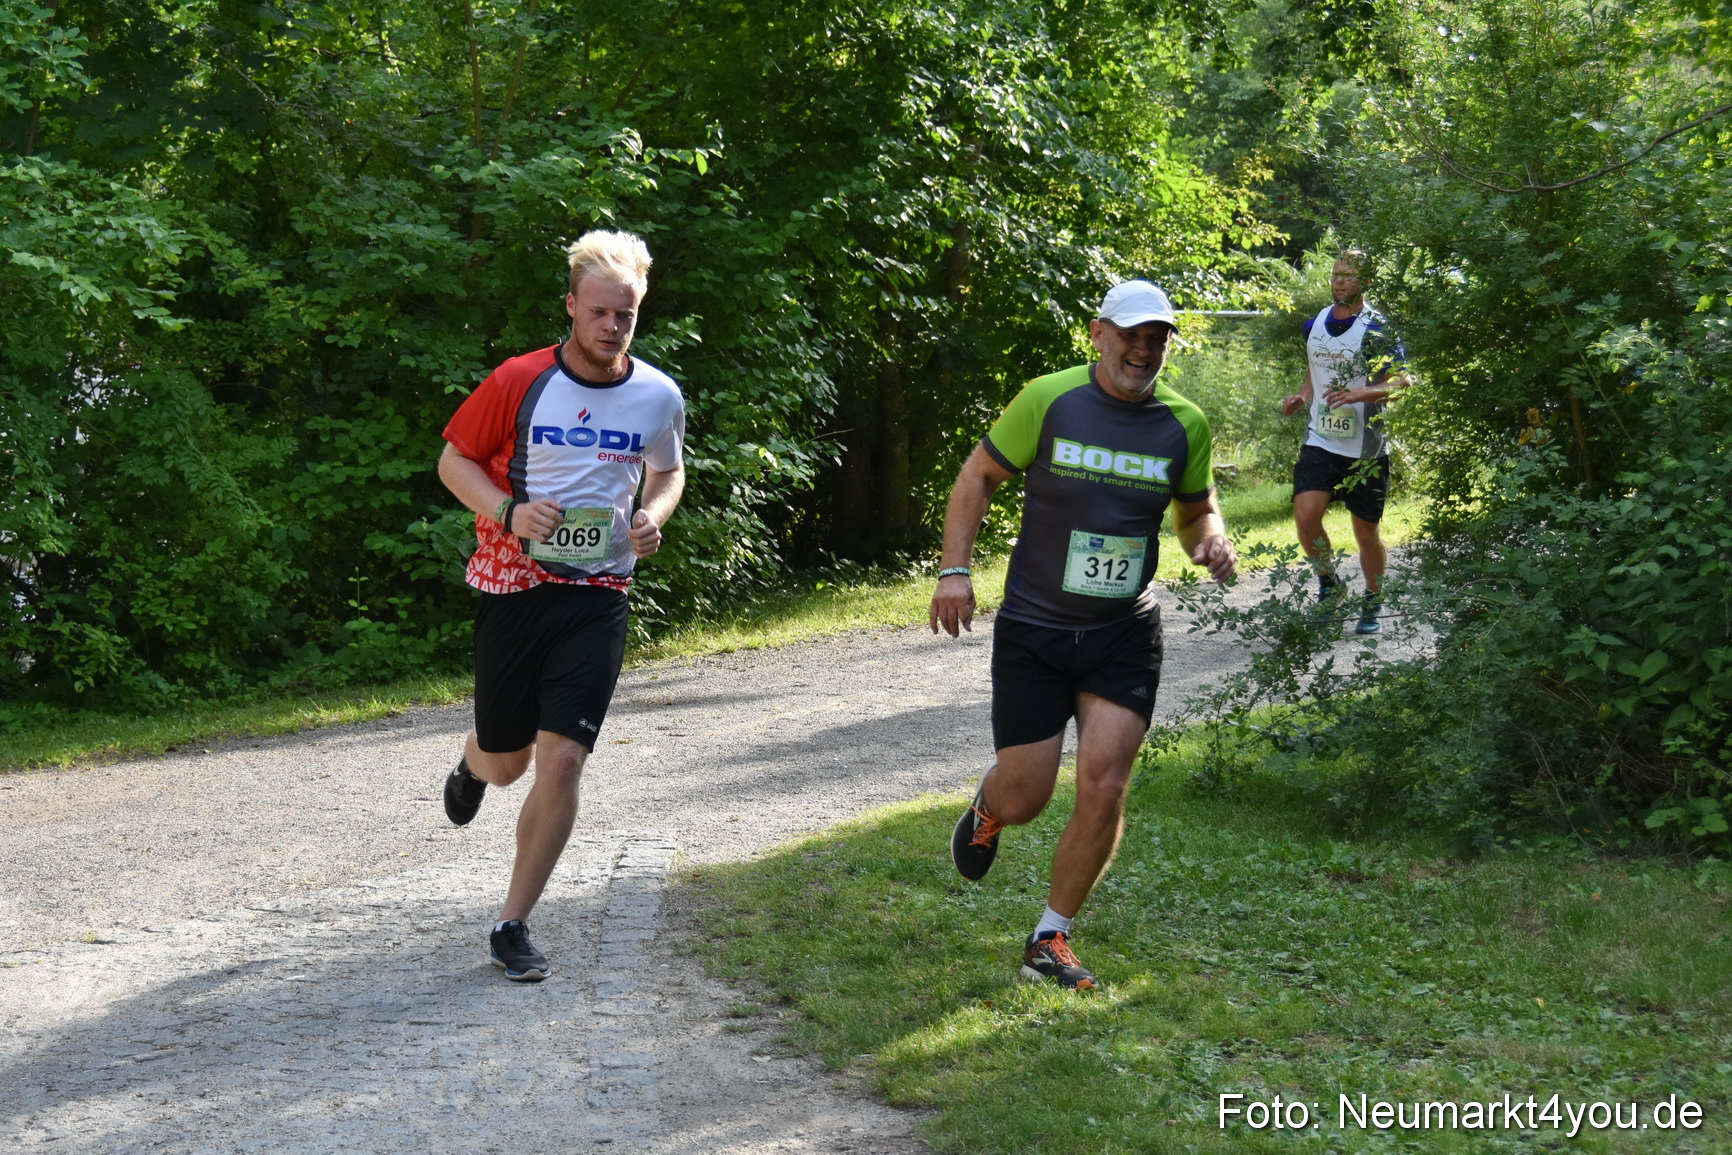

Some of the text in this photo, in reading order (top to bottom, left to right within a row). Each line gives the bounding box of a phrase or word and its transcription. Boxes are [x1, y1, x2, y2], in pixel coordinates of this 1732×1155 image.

[1320, 416, 1350, 431] 1146
[1053, 440, 1170, 482] BOCK
[1049, 465, 1086, 479] inspired
[1088, 473, 1101, 483] by
[1103, 477, 1132, 488] smart
[1084, 556, 1129, 581] 312
